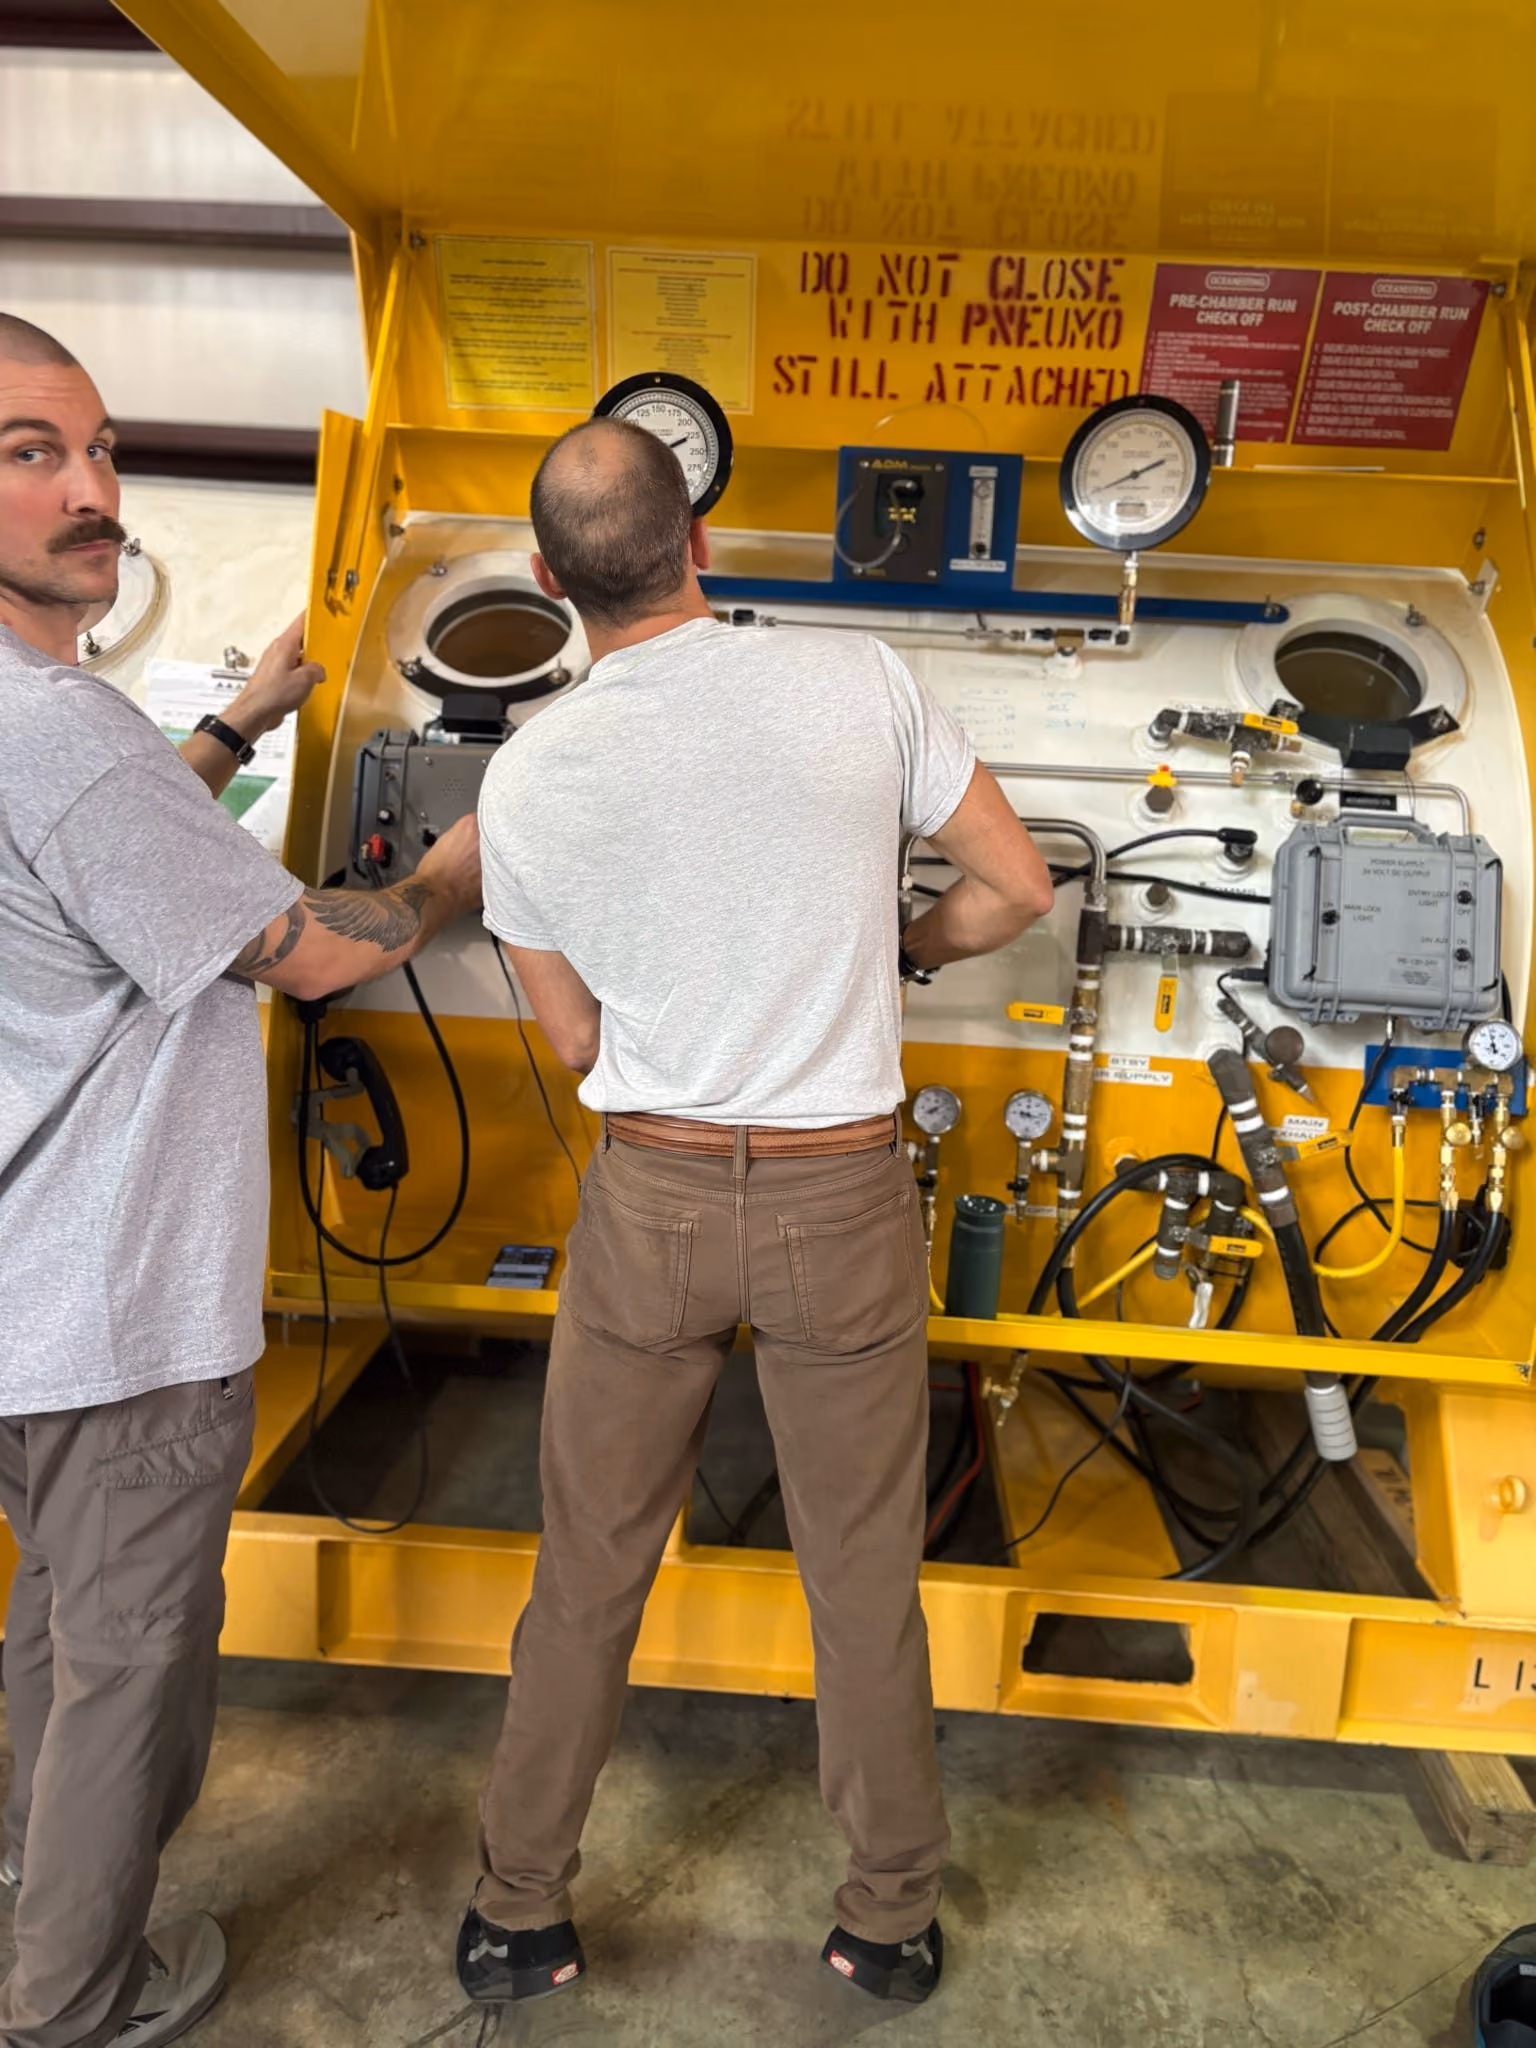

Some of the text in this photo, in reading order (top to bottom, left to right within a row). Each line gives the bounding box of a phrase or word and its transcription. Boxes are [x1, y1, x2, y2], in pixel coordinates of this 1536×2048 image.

[800, 252, 1126, 302] DO NOT CLOSE
[1169, 293, 1298, 312] PRE-CHAMBER RUN
[1196, 311, 1265, 327] CHECK OFF
[1332, 302, 1470, 321] POST-CHAMBER RUN
[829, 298, 1123, 350] WITH PNEUMO
[1363, 318, 1432, 334] CHECK OFF
[773, 355, 899, 399] STILL
[924, 363, 1131, 408] ATTACHED
[637, 408, 651, 417] 125
[652, 404, 666, 413] 150
[667, 409, 682, 418] 175
[677, 418, 693, 427] 200
[689, 448, 704, 456] 250
[1114, 1071, 1170, 1082] SUPPLY
[1287, 1118, 1324, 1127] MAIN
[1473, 1657, 1490, 1690] L
